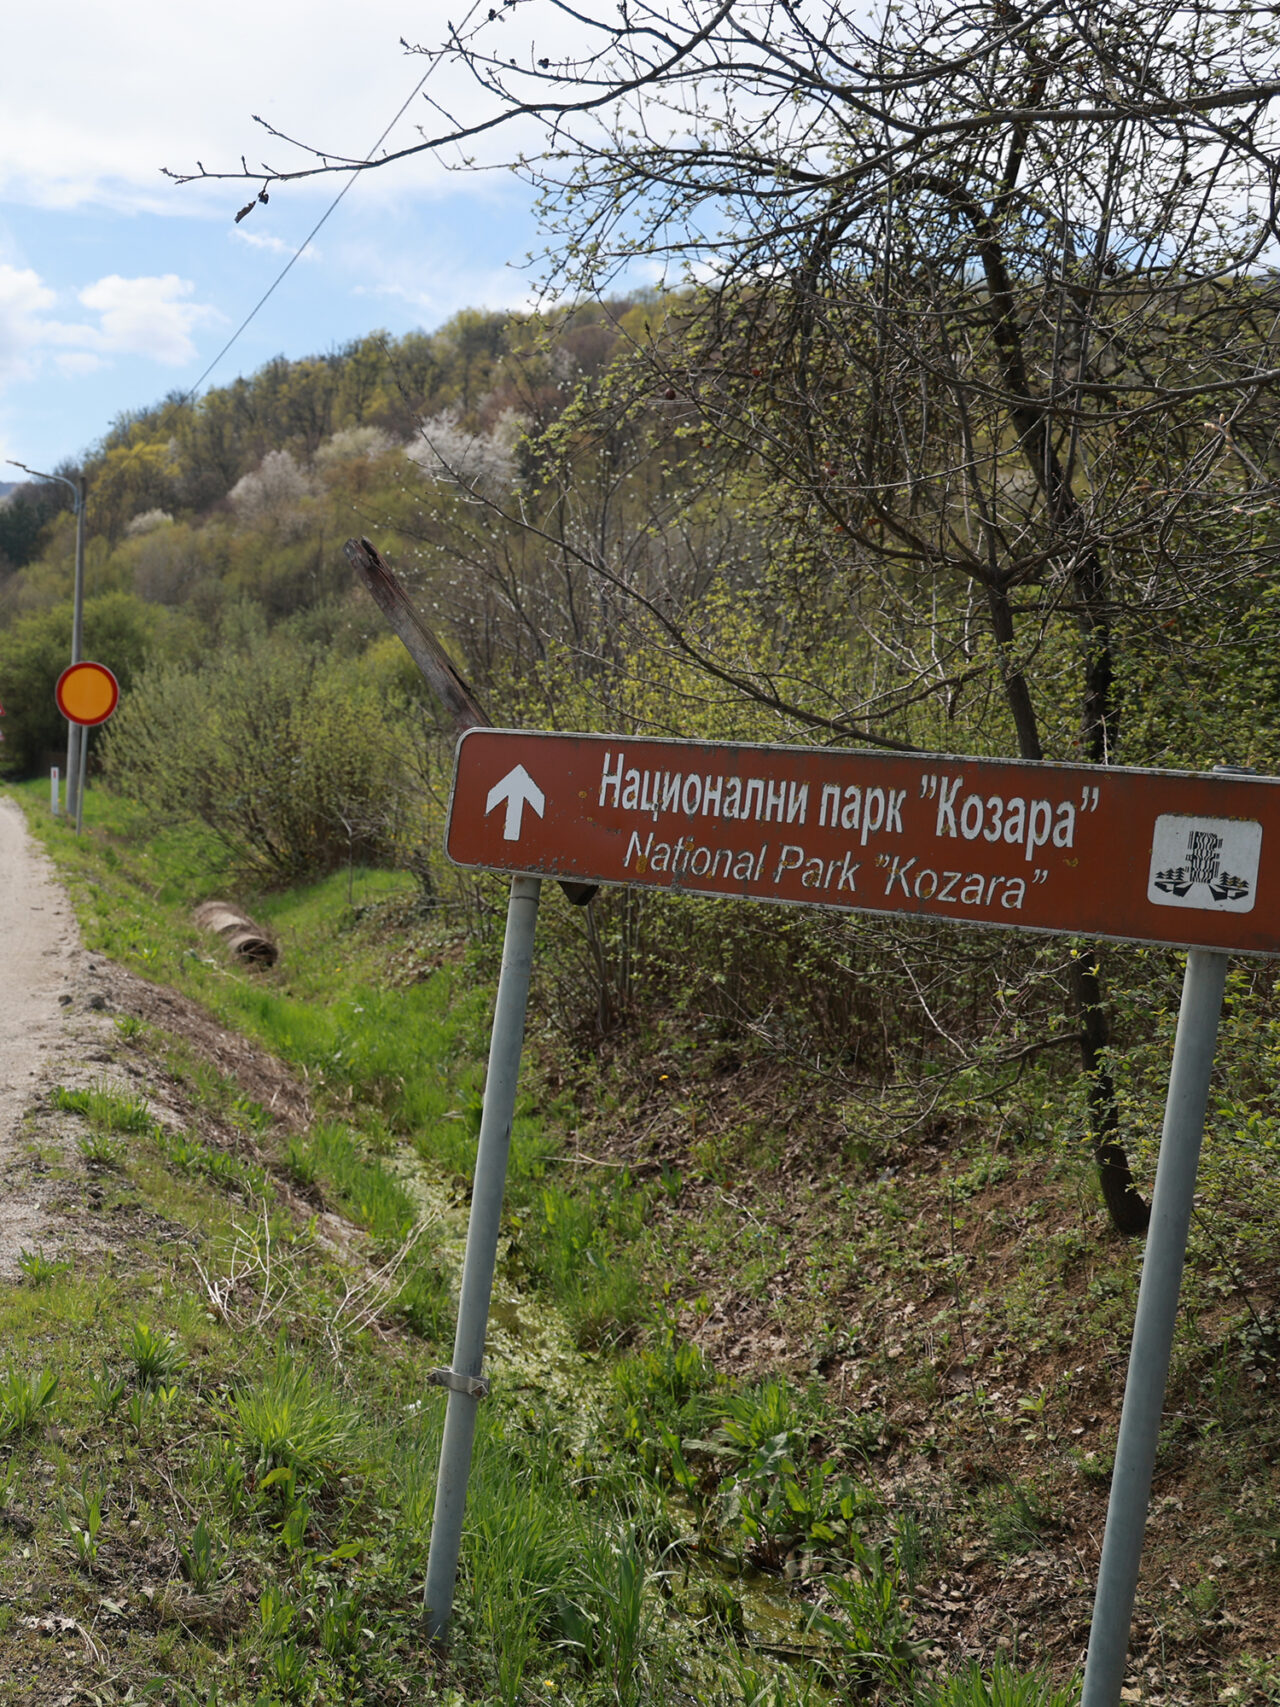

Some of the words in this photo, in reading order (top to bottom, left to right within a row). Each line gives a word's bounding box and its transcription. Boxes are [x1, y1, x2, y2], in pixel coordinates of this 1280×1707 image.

[599, 752, 809, 824] Национални
[819, 782, 907, 846] парк
[623, 830, 768, 881] National
[773, 844, 861, 892] Park
